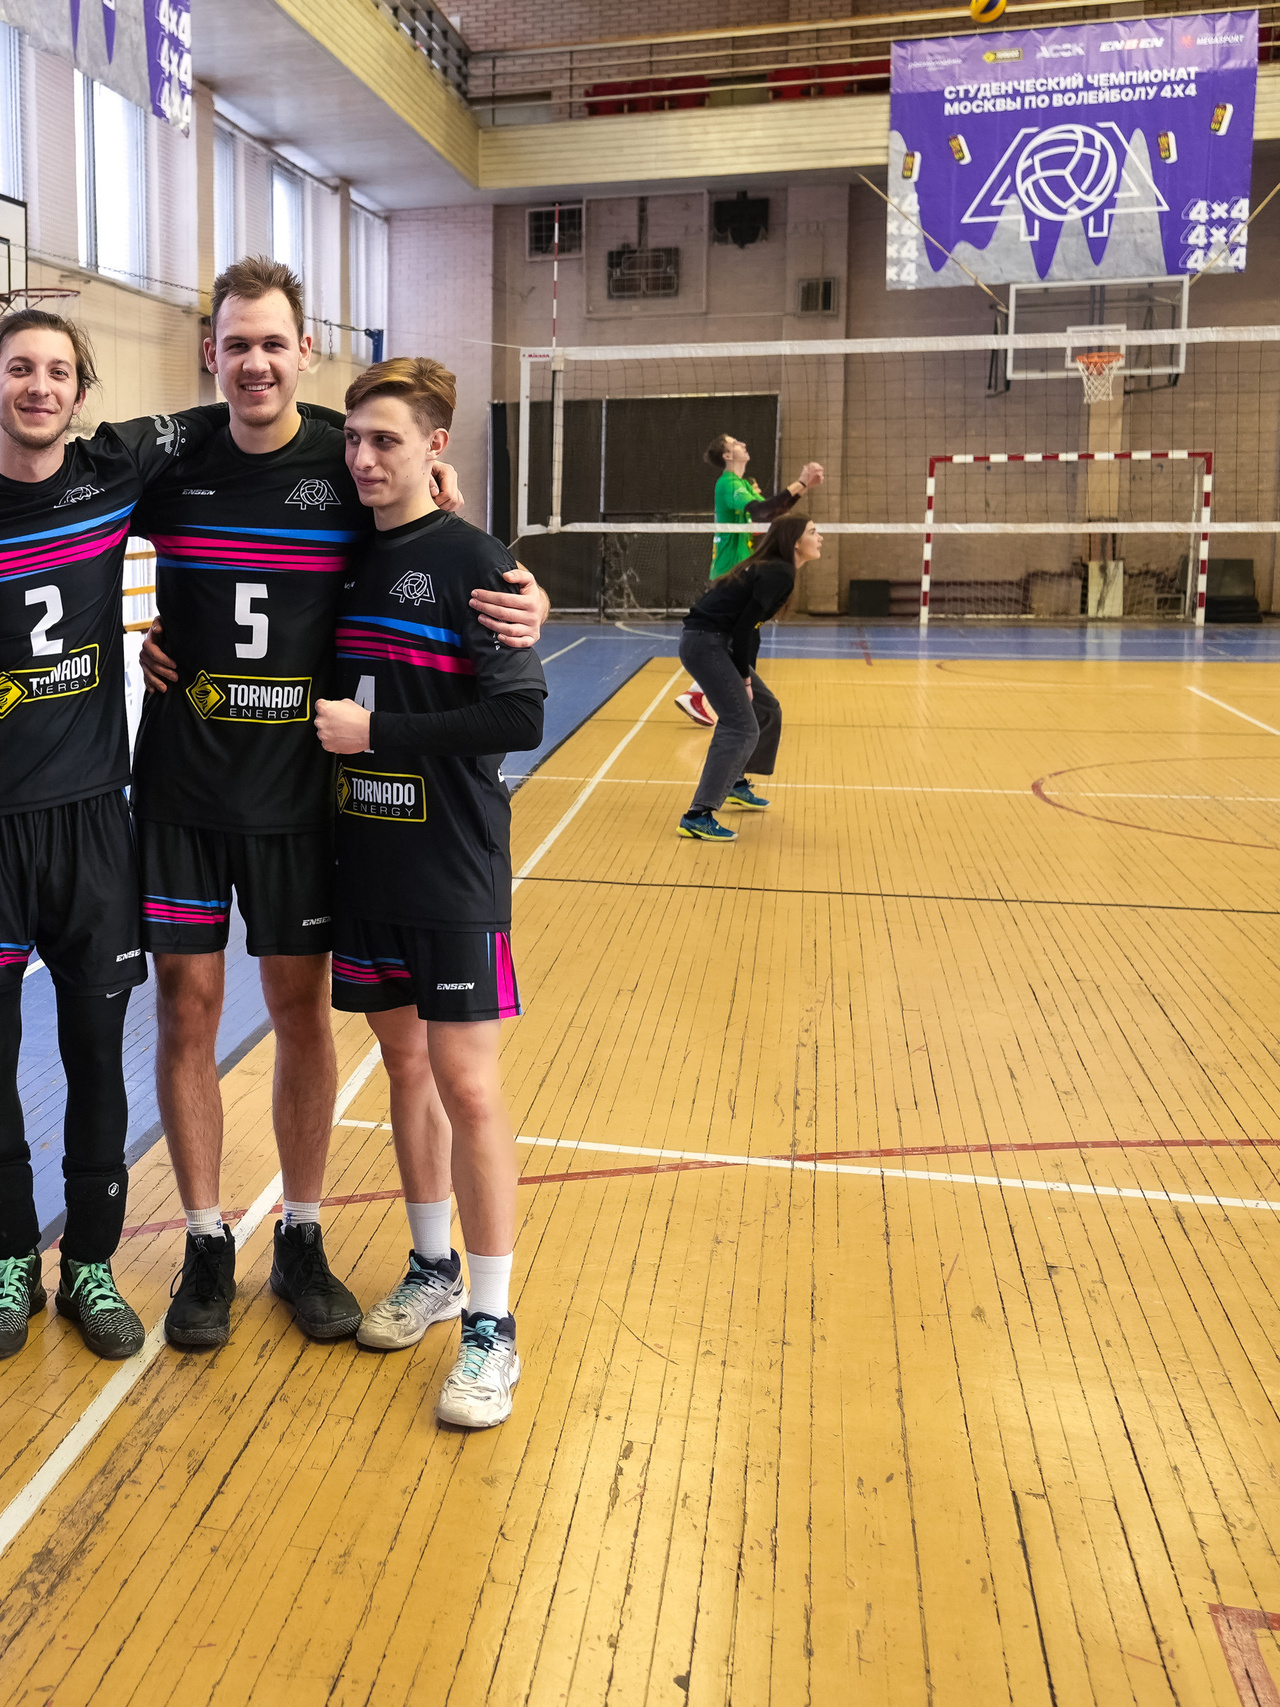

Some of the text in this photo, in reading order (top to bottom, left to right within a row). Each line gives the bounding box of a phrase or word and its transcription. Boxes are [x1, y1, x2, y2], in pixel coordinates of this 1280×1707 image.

[944, 66, 1199, 100] СТУДЕНЧЕСКИЙ ЧЕМПИОНАТ
[944, 96, 1021, 116] МОСКВЫ
[1024, 94, 1050, 110] ПО
[1052, 85, 1158, 107] ВОЛЕЙБОЛУ
[181, 488, 216, 496] ENSEN
[25, 584, 64, 657] 2
[234, 582, 269, 659] 5
[227, 683, 304, 709] TORNADO
[229, 707, 300, 719] ENERGY
[351, 777, 416, 806] TORNADO
[352, 802, 415, 817] ENERGY
[436, 982, 475, 990] ENSEN
